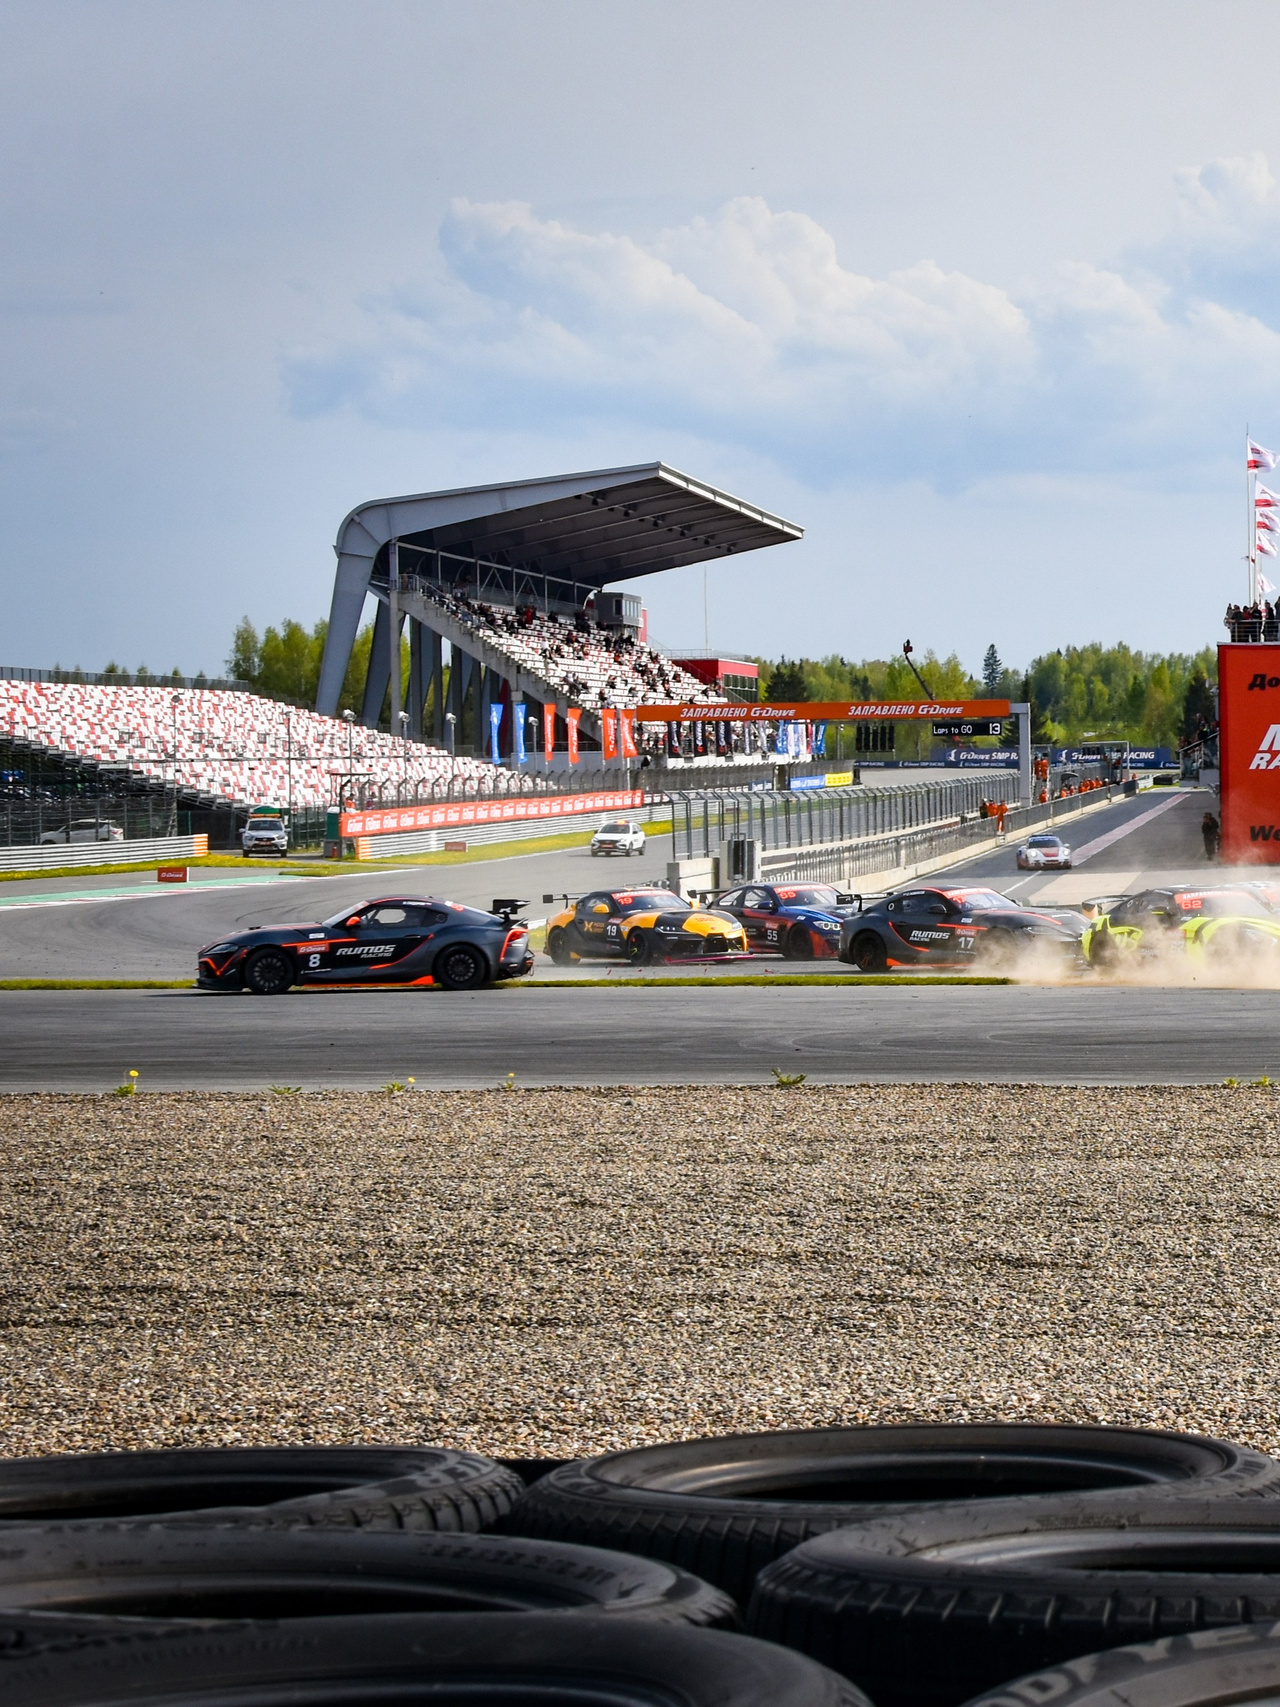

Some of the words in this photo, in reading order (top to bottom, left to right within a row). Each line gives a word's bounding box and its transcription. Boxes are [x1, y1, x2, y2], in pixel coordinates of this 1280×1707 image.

[680, 707, 748, 718] ЗАПРАВЛЕНО
[848, 705, 915, 716] ЗАПРАВЛЕНО
[933, 726, 949, 735] Laps
[951, 727, 959, 735] to
[961, 725, 973, 735] GO
[989, 723, 1001, 735] 13
[618, 897, 634, 905] 19
[1182, 900, 1202, 909] 62
[606, 925, 617, 936] 19
[767, 930, 778, 941] 55
[911, 930, 951, 940] RUMOS
[958, 937, 975, 950] 17
[336, 944, 397, 956] RUMOS
[308, 953, 321, 968] 8
